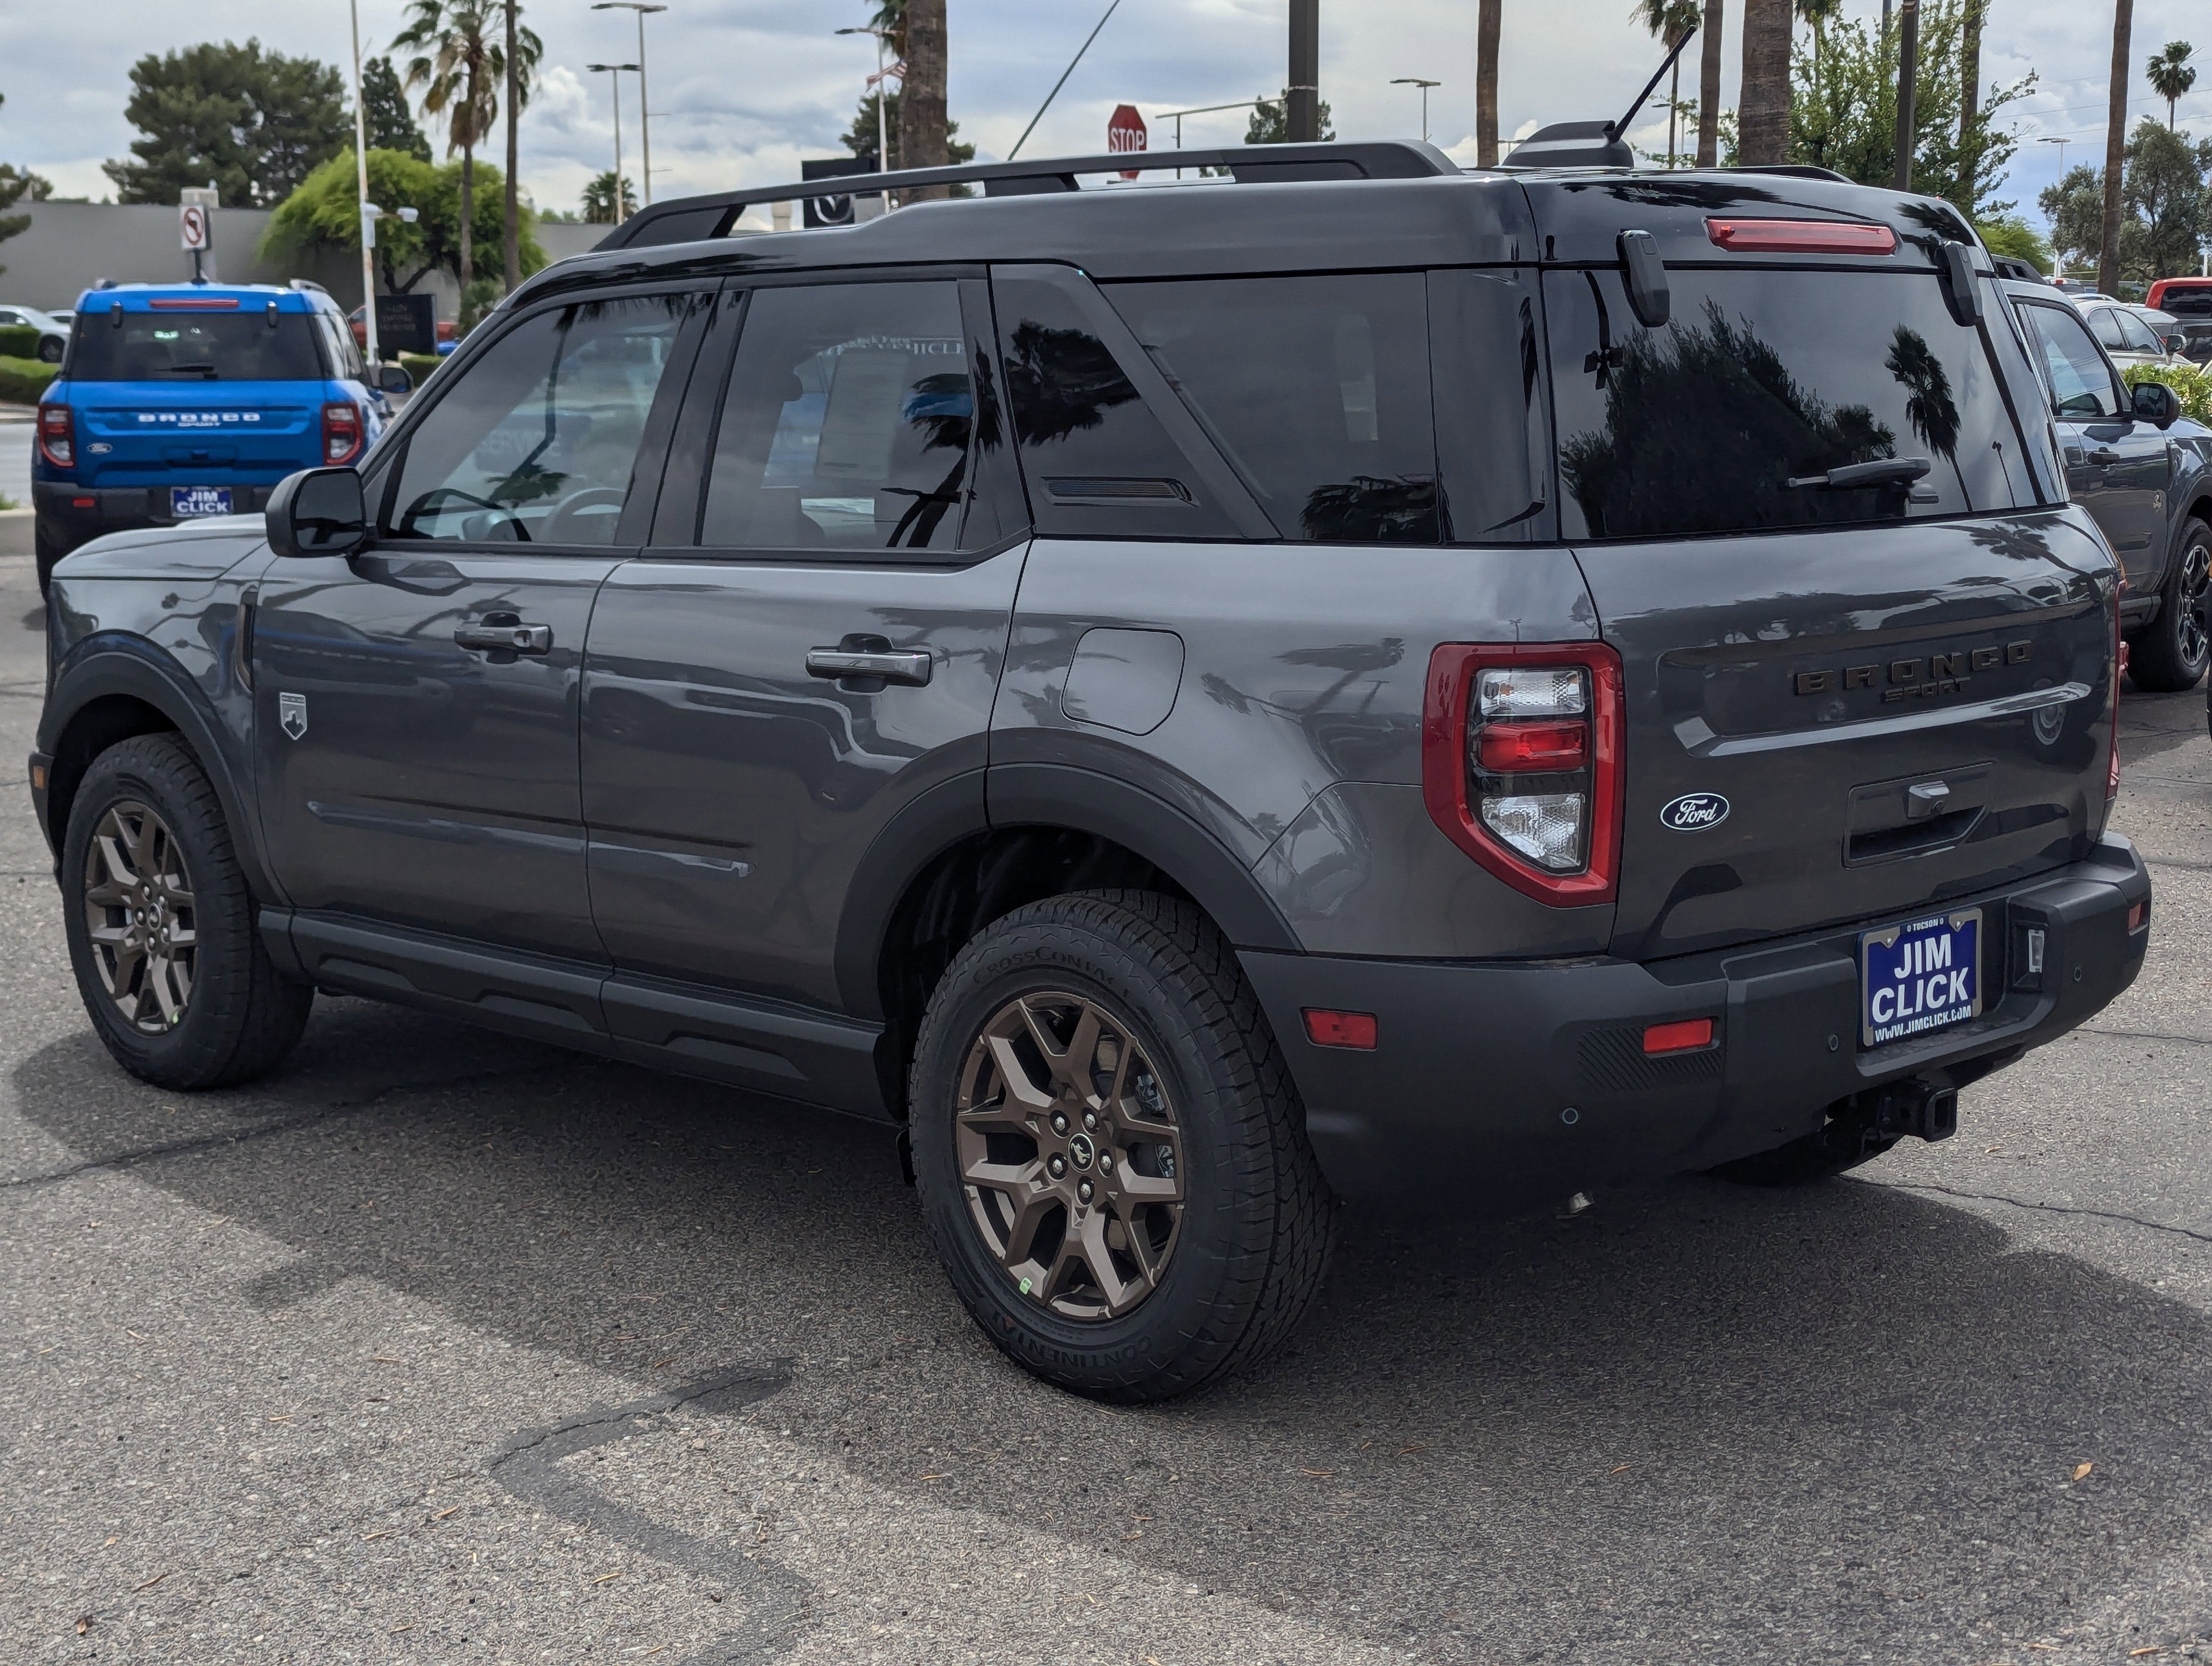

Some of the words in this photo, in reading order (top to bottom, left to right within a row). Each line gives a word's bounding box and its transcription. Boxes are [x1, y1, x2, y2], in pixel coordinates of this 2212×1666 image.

[1110, 127, 1144, 152] STOP
[177, 501, 228, 512] CLICK
[187, 491, 218, 502] JIM
[1795, 639, 2032, 695] BRONCO
[1883, 676, 1971, 702] SPORT
[1675, 799, 1718, 824] Ford
[1912, 918, 1939, 931] TUCSON
[1894, 933, 1952, 979] JIM
[1872, 966, 1969, 1023] CLICK
[1875, 1005, 1972, 1042] WWW.JIMCLICK.COM
